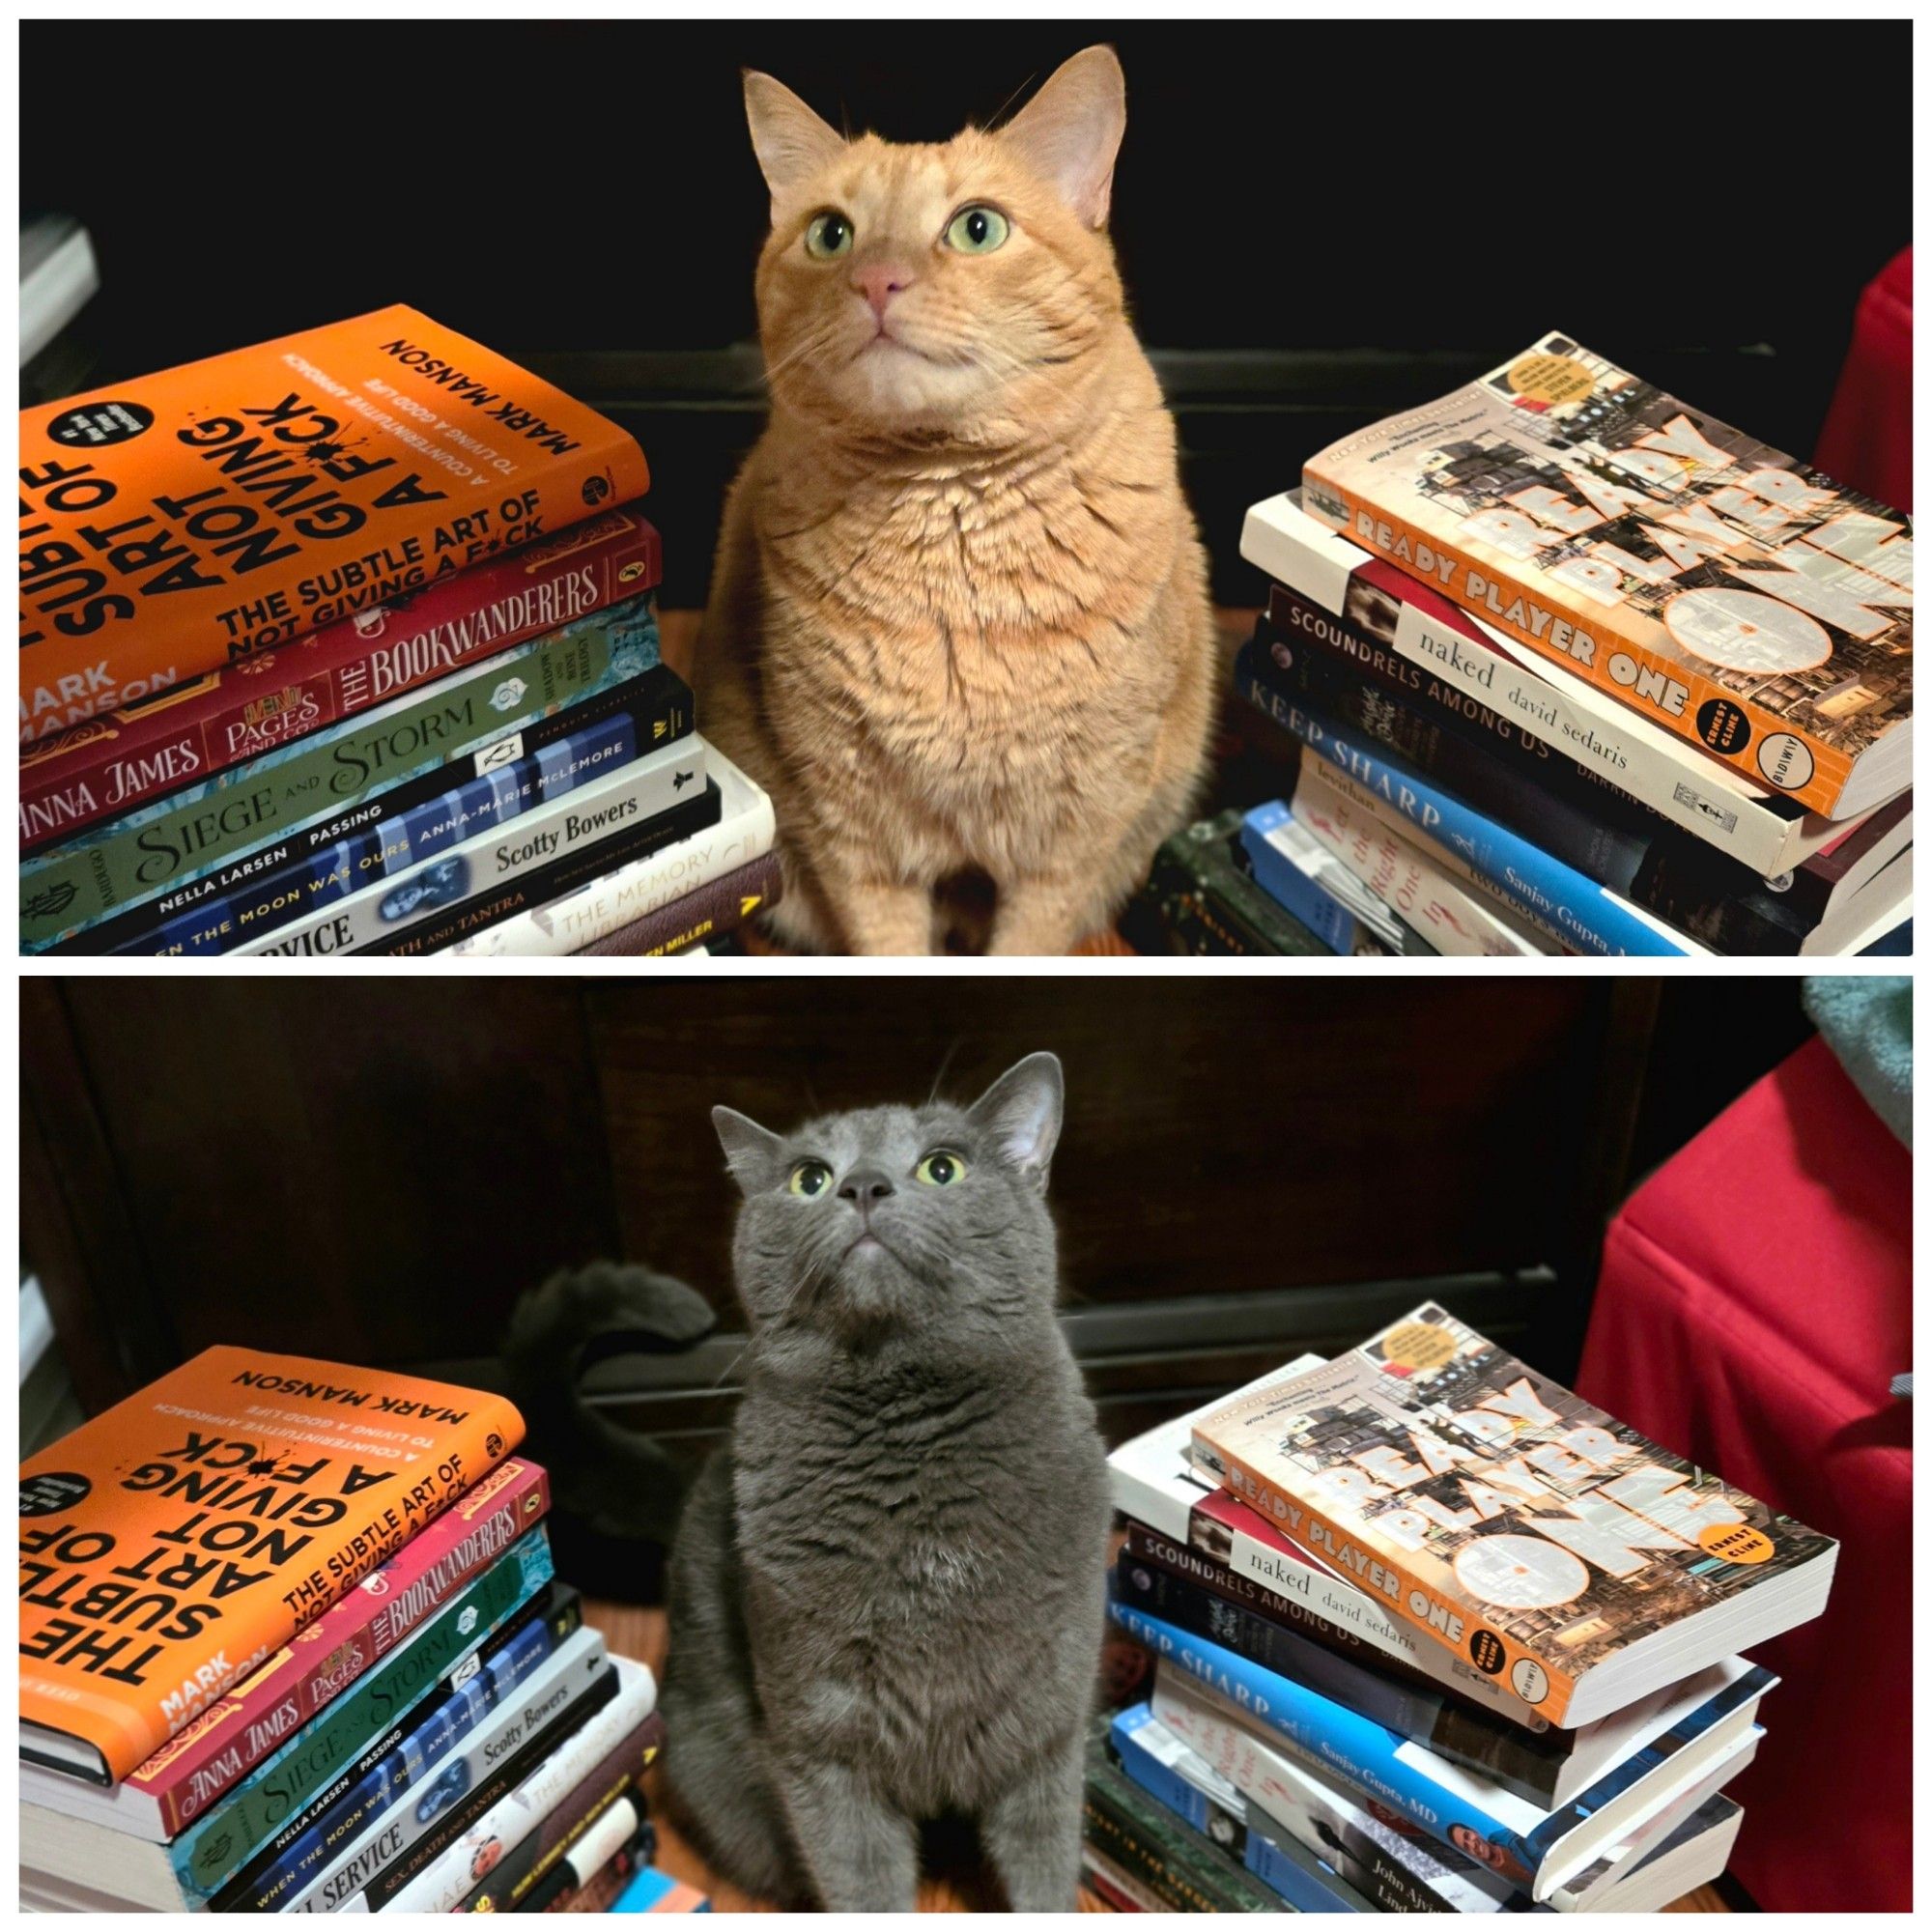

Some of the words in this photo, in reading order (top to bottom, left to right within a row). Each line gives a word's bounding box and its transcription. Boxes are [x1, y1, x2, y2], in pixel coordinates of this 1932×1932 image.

[379, 339, 500, 407] MANSON
[392, 397, 438, 424] GOOD
[345, 397, 473, 476] COUNTERINTUITIVE
[446, 428, 497, 456] LIVING
[485, 400, 581, 456] MARK
[494, 459, 519, 474] TO
[1329, 443, 1358, 463] New
[19, 461, 118, 513] OF
[177, 416, 367, 540] GIVING
[371, 472, 448, 508] A
[1455, 413, 1738, 561] READY
[76, 515, 228, 596] ART
[151, 486, 302, 575] NOT
[216, 590, 291, 637] THE
[298, 537, 425, 606] SUBTLE
[434, 508, 490, 553] ART
[499, 489, 541, 523] OF
[1545, 468, 1840, 609] PLAYER
[226, 616, 300, 661] NOT
[312, 565, 425, 626] GIVING
[435, 555, 458, 579] A
[340, 660, 369, 712] THE
[370, 564, 600, 696] BOOKWANDERERS
[1356, 508, 1459, 585] READY
[1464, 569, 1597, 670] PLAYER
[1607, 651, 1690, 720] ONE
[1291, 606, 1421, 691] SCOUNDRELS
[1427, 682, 1512, 738] AMONG
[1520, 732, 1551, 759] US
[1420, 632, 1495, 691] naked
[1508, 686, 1559, 729] david
[1561, 719, 1630, 770] sedaris
[225, 692, 321, 753] PAGES
[1706, 701, 1729, 746] ERNEST
[1721, 712, 1741, 748] CLINE
[104, 739, 201, 805] JAMES
[134, 787, 277, 886] SIEGE
[285, 775, 321, 802] AND
[328, 697, 475, 794] STORM
[1251, 678, 1324, 743] KEEP
[1334, 741, 1440, 829] SHARP
[1504, 866, 1552, 915] Sanjay
[158, 880, 216, 914] NELLA
[220, 846, 288, 887] LARSEN
[309, 804, 383, 846] PASSING
[191, 920, 233, 946] THE
[240, 888, 300, 924] MOON
[308, 867, 352, 893] WAS
[358, 838, 410, 870] OURS
[419, 783, 532, 842] ANNA-MARIE
[495, 827, 560, 873] Scotty
[565, 796, 639, 842] Bowers
[1371, 837, 1402, 897] Right
[427, 924, 456, 947] AND
[458, 892, 525, 930] TANTRA
[562, 898, 607, 933] THE
[617, 845, 713, 907] MEMORY
[1395, 865, 1423, 912] One
[667, 920, 713, 946] MILLER
[231, 1371, 373, 1406] MANSON
[372, 1396, 469, 1426] MARK
[241, 1422, 402, 1461] COUNTERINTUITIVE
[351, 1424, 408, 1444] LIVING
[410, 1435, 435, 1449] TO
[1310, 1377, 1563, 1509] READY
[120, 1463, 348, 1528] GIVING
[340, 1463, 397, 1496] A
[1363, 1426, 1645, 1554] PLAYER
[19, 1523, 117, 1564] OF
[152, 1512, 315, 1566] NOT
[282, 1569, 327, 1613] THE
[328, 1509, 397, 1577] SUBTLE
[402, 1476, 438, 1511] ART
[438, 1454, 464, 1484] OF
[1231, 1466, 1303, 1534] READY
[1309, 1520, 1401, 1603] PLAYER
[1408, 1591, 1465, 1644] ONE
[1453, 1464, 1747, 1610] ONE
[1707, 1523, 1755, 1553] ERNEST
[1727, 1538, 1765, 1560] CLINE
[109, 1547, 276, 1600] ART
[294, 1588, 335, 1630] NOT
[340, 1534, 403, 1592] GIVING
[371, 1610, 391, 1656] THE
[386, 1502, 516, 1638] BOOKWANDERERS
[1146, 1538, 1256, 1600] SCOUNDRELS
[1261, 1592, 1331, 1634] AMONG
[1337, 1625, 1362, 1647] US
[1251, 1550, 1311, 1596] naked
[1321, 1591, 1362, 1623] david
[1365, 1615, 1418, 1653] sedaris
[19, 1617, 165, 1687] THE
[159, 1650, 234, 1720] MARK
[311, 1644, 364, 1707] PAGES
[264, 1726, 344, 1824] SIEGE
[369, 1629, 454, 1729] STORM
[484, 1723, 523, 1767] Scotty
[523, 1685, 570, 1731] Bowers
[1110, 1602, 1174, 1654] KEEP
[1180, 1647, 1270, 1717] SHARP
[1321, 1740, 1365, 1781] Sanjay
[1408, 1794, 1438, 1826] MD
[182, 1752, 242, 1817] ANNA
[244, 1697, 299, 1762] JAMES
[275, 1811, 309, 1849] NELLA
[310, 1776, 350, 1817] LARSEN
[358, 1729, 403, 1772] PASSING
[257, 1870, 297, 1909] WHEN
[298, 1846, 326, 1871] THE
[326, 1809, 362, 1846] MOON
[364, 1784, 391, 1811] WAS
[393, 1753, 423, 1784] OURS
[426, 1688, 494, 1755] ANNA-MARIE
[410, 1833, 447, 1872] DEATH
[466, 1780, 508, 1818] TANTRA
[322, 1823, 405, 1911] SERVICE
[1372, 1859, 1406, 1892] John
